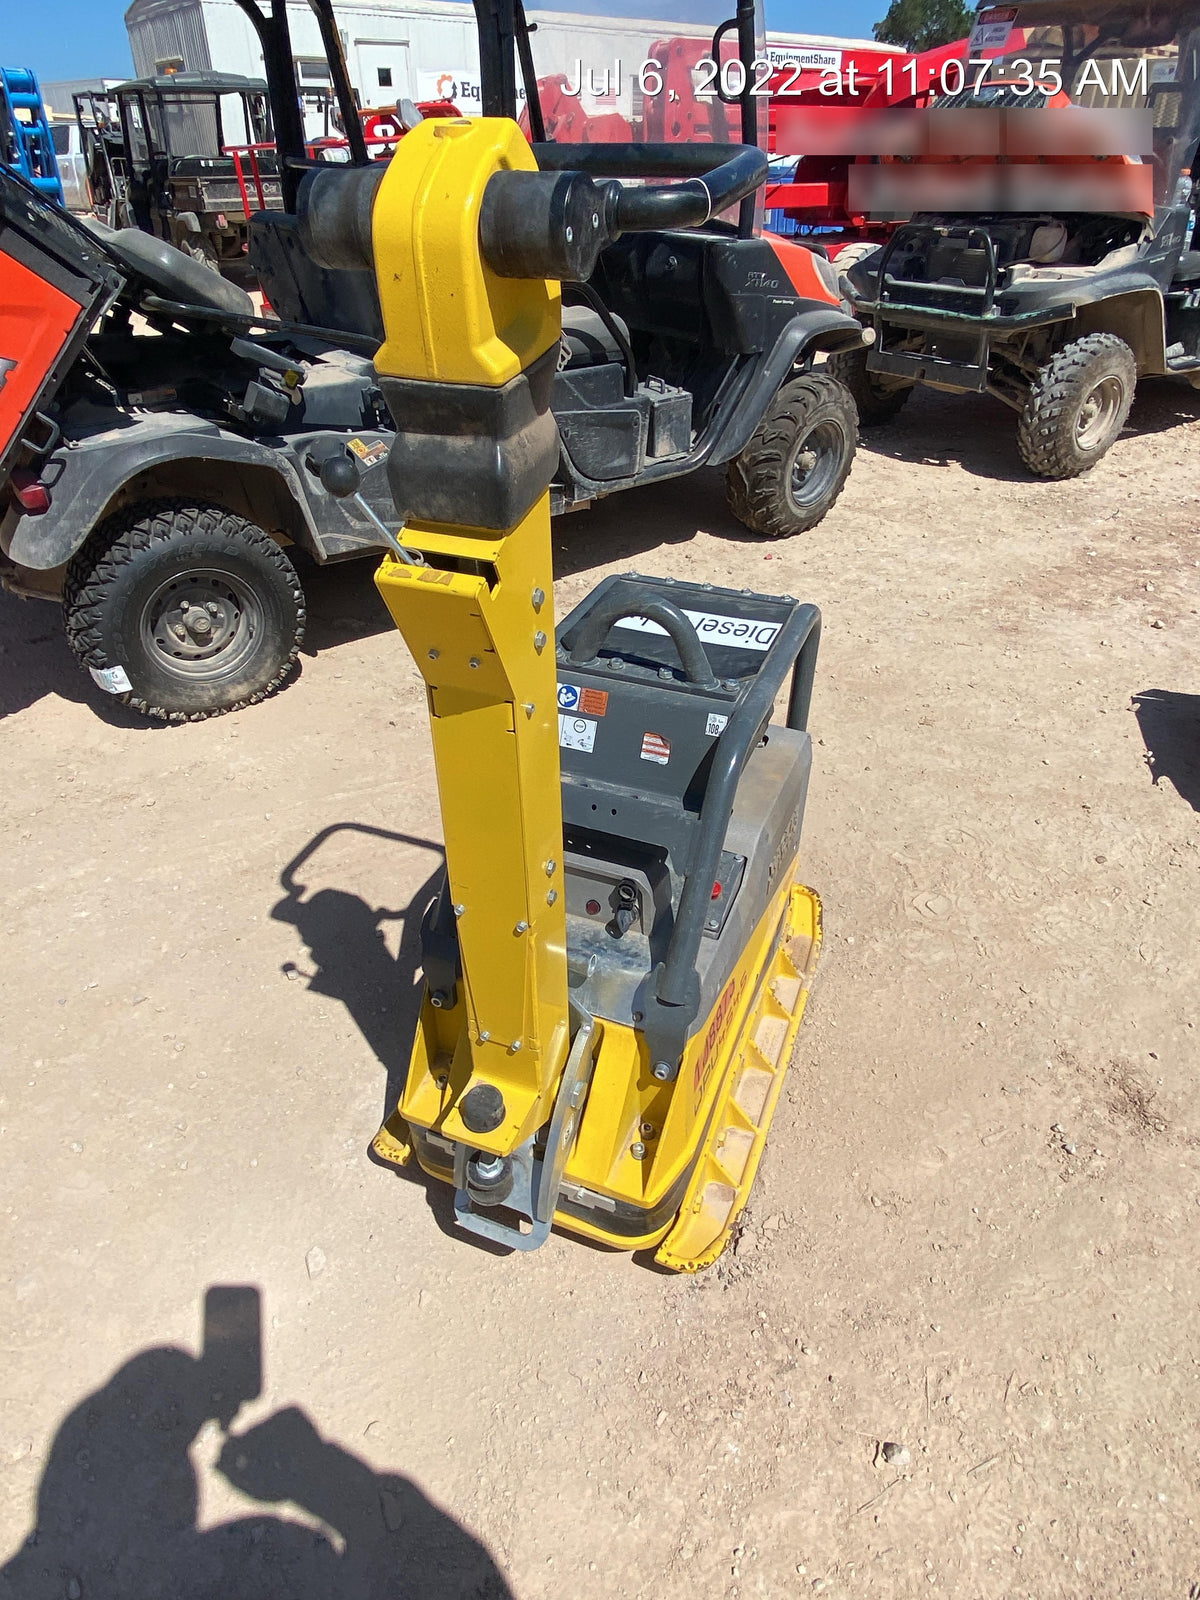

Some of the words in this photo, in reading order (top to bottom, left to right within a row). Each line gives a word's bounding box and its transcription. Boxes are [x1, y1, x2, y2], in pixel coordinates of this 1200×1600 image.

[770, 51, 836, 65] EquipmentShare
[696, 617, 778, 645] Diesel
[708, 723, 720, 735] 108
